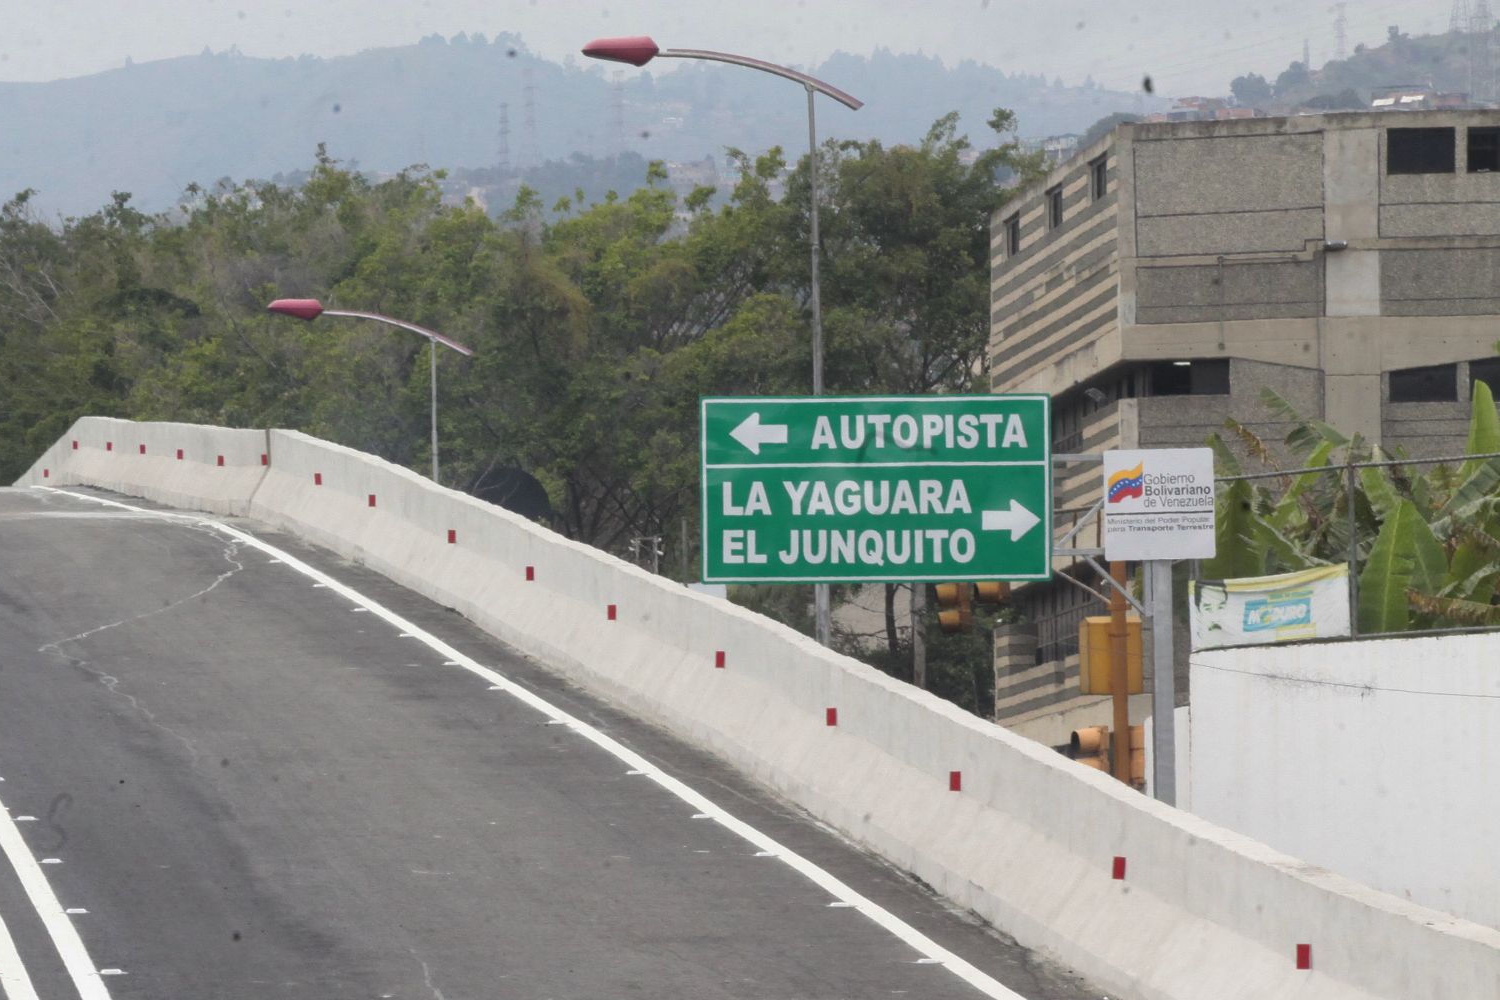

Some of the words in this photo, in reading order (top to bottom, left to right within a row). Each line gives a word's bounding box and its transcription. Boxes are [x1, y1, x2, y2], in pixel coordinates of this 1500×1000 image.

[811, 413, 1028, 450] AUTOPISTA
[1143, 472, 1195, 485] Gobierno
[1144, 484, 1211, 496] Bolivariano
[722, 480, 772, 516] LA
[783, 479, 972, 516] YAGUARA
[1143, 496, 1157, 508] de
[1159, 495, 1214, 508] Venezuela
[1128, 524, 1174, 532] Transporte
[1176, 523, 1214, 531] Terrestre
[722, 529, 768, 564] EL
[779, 528, 976, 567] JUNQUITO
